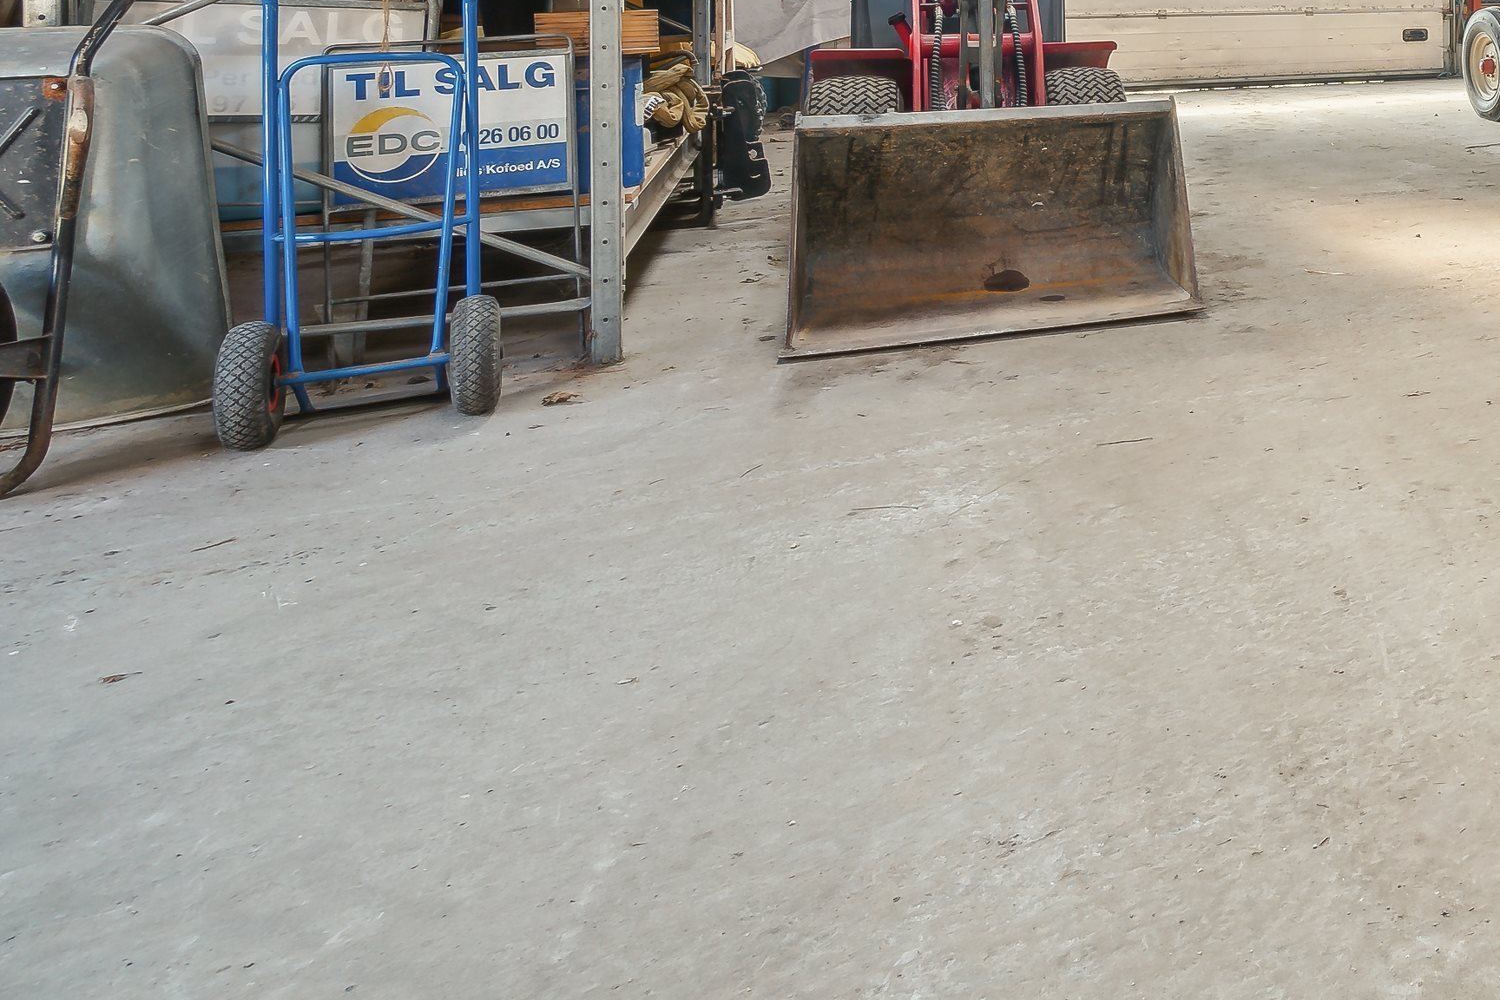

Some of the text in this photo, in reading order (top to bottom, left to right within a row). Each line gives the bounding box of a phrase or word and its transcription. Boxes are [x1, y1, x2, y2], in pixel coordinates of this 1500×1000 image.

[346, 71, 420, 100] TIL
[508, 126, 531, 142] 06
[537, 123, 559, 139] 00
[347, 131, 440, 157] EDC
[486, 161, 533, 175] Kofoed
[536, 158, 560, 170] A/S
